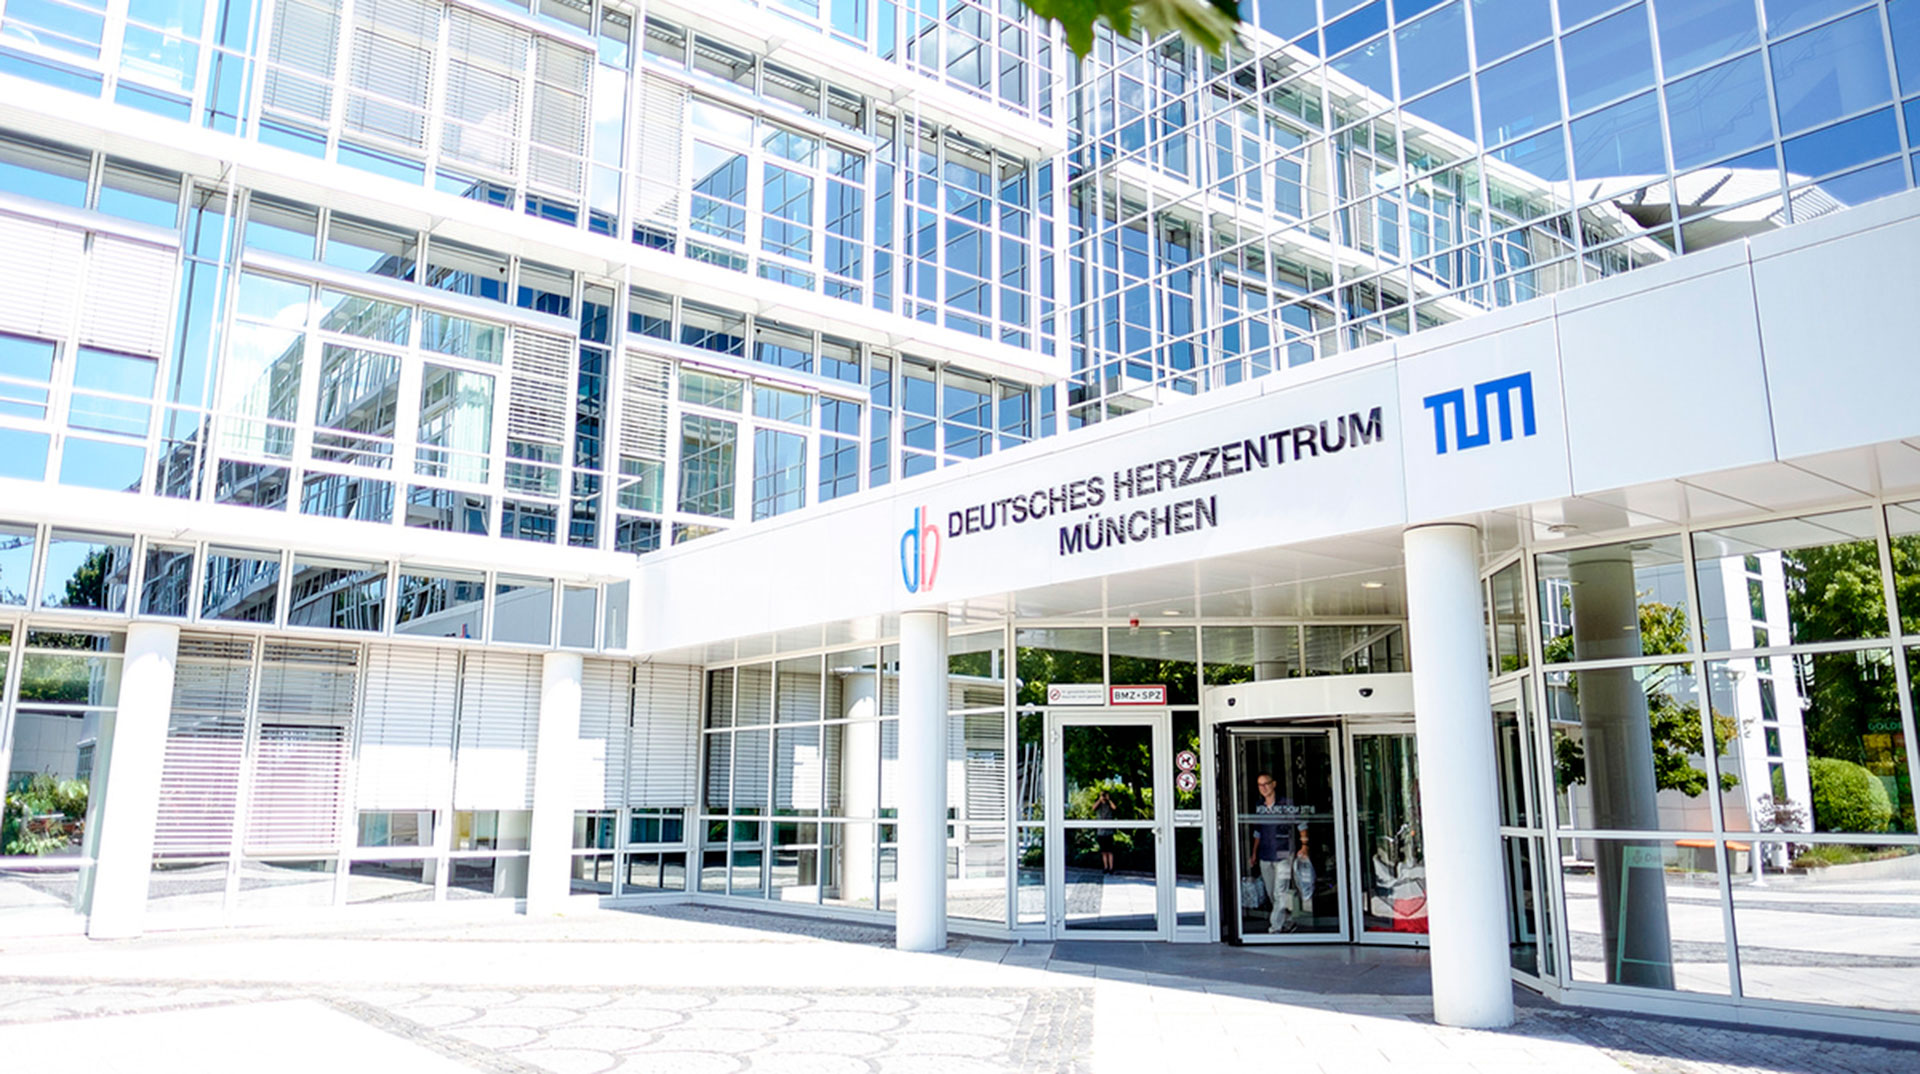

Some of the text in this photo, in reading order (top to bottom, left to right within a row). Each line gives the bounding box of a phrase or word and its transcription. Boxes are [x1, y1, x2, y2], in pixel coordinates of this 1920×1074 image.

[1423, 371, 1537, 455] TUM
[948, 406, 1383, 539] DEUTSCHES HERZZENTRUM
[1059, 494, 1218, 556] MÜNCHEN
